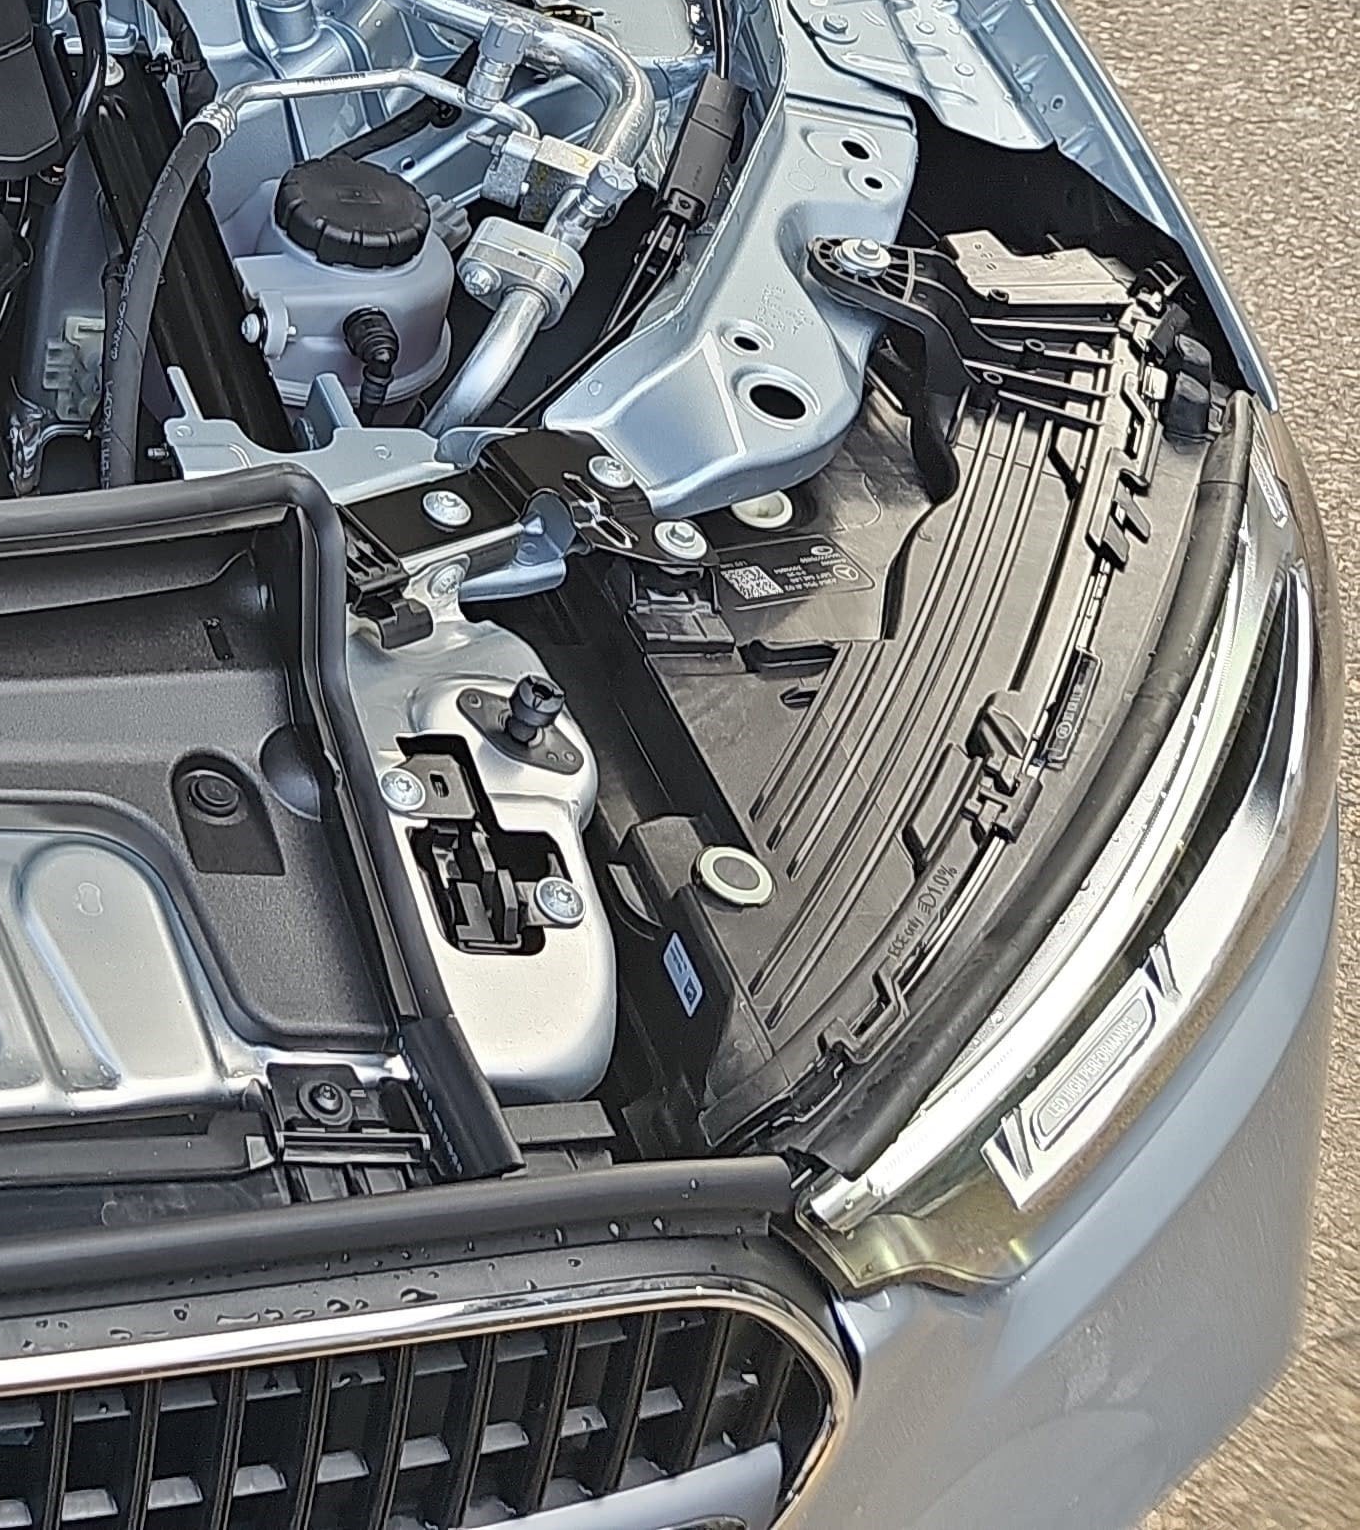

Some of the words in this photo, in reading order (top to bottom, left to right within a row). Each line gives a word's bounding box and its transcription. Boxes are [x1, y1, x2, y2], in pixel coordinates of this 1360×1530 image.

[927, 862, 958, 898] 1.0%
[1046, 1096, 1070, 1118] LED
[1060, 1075, 1088, 1103] HIGH
[1079, 1016, 1138, 1081] PERFORMANCE
